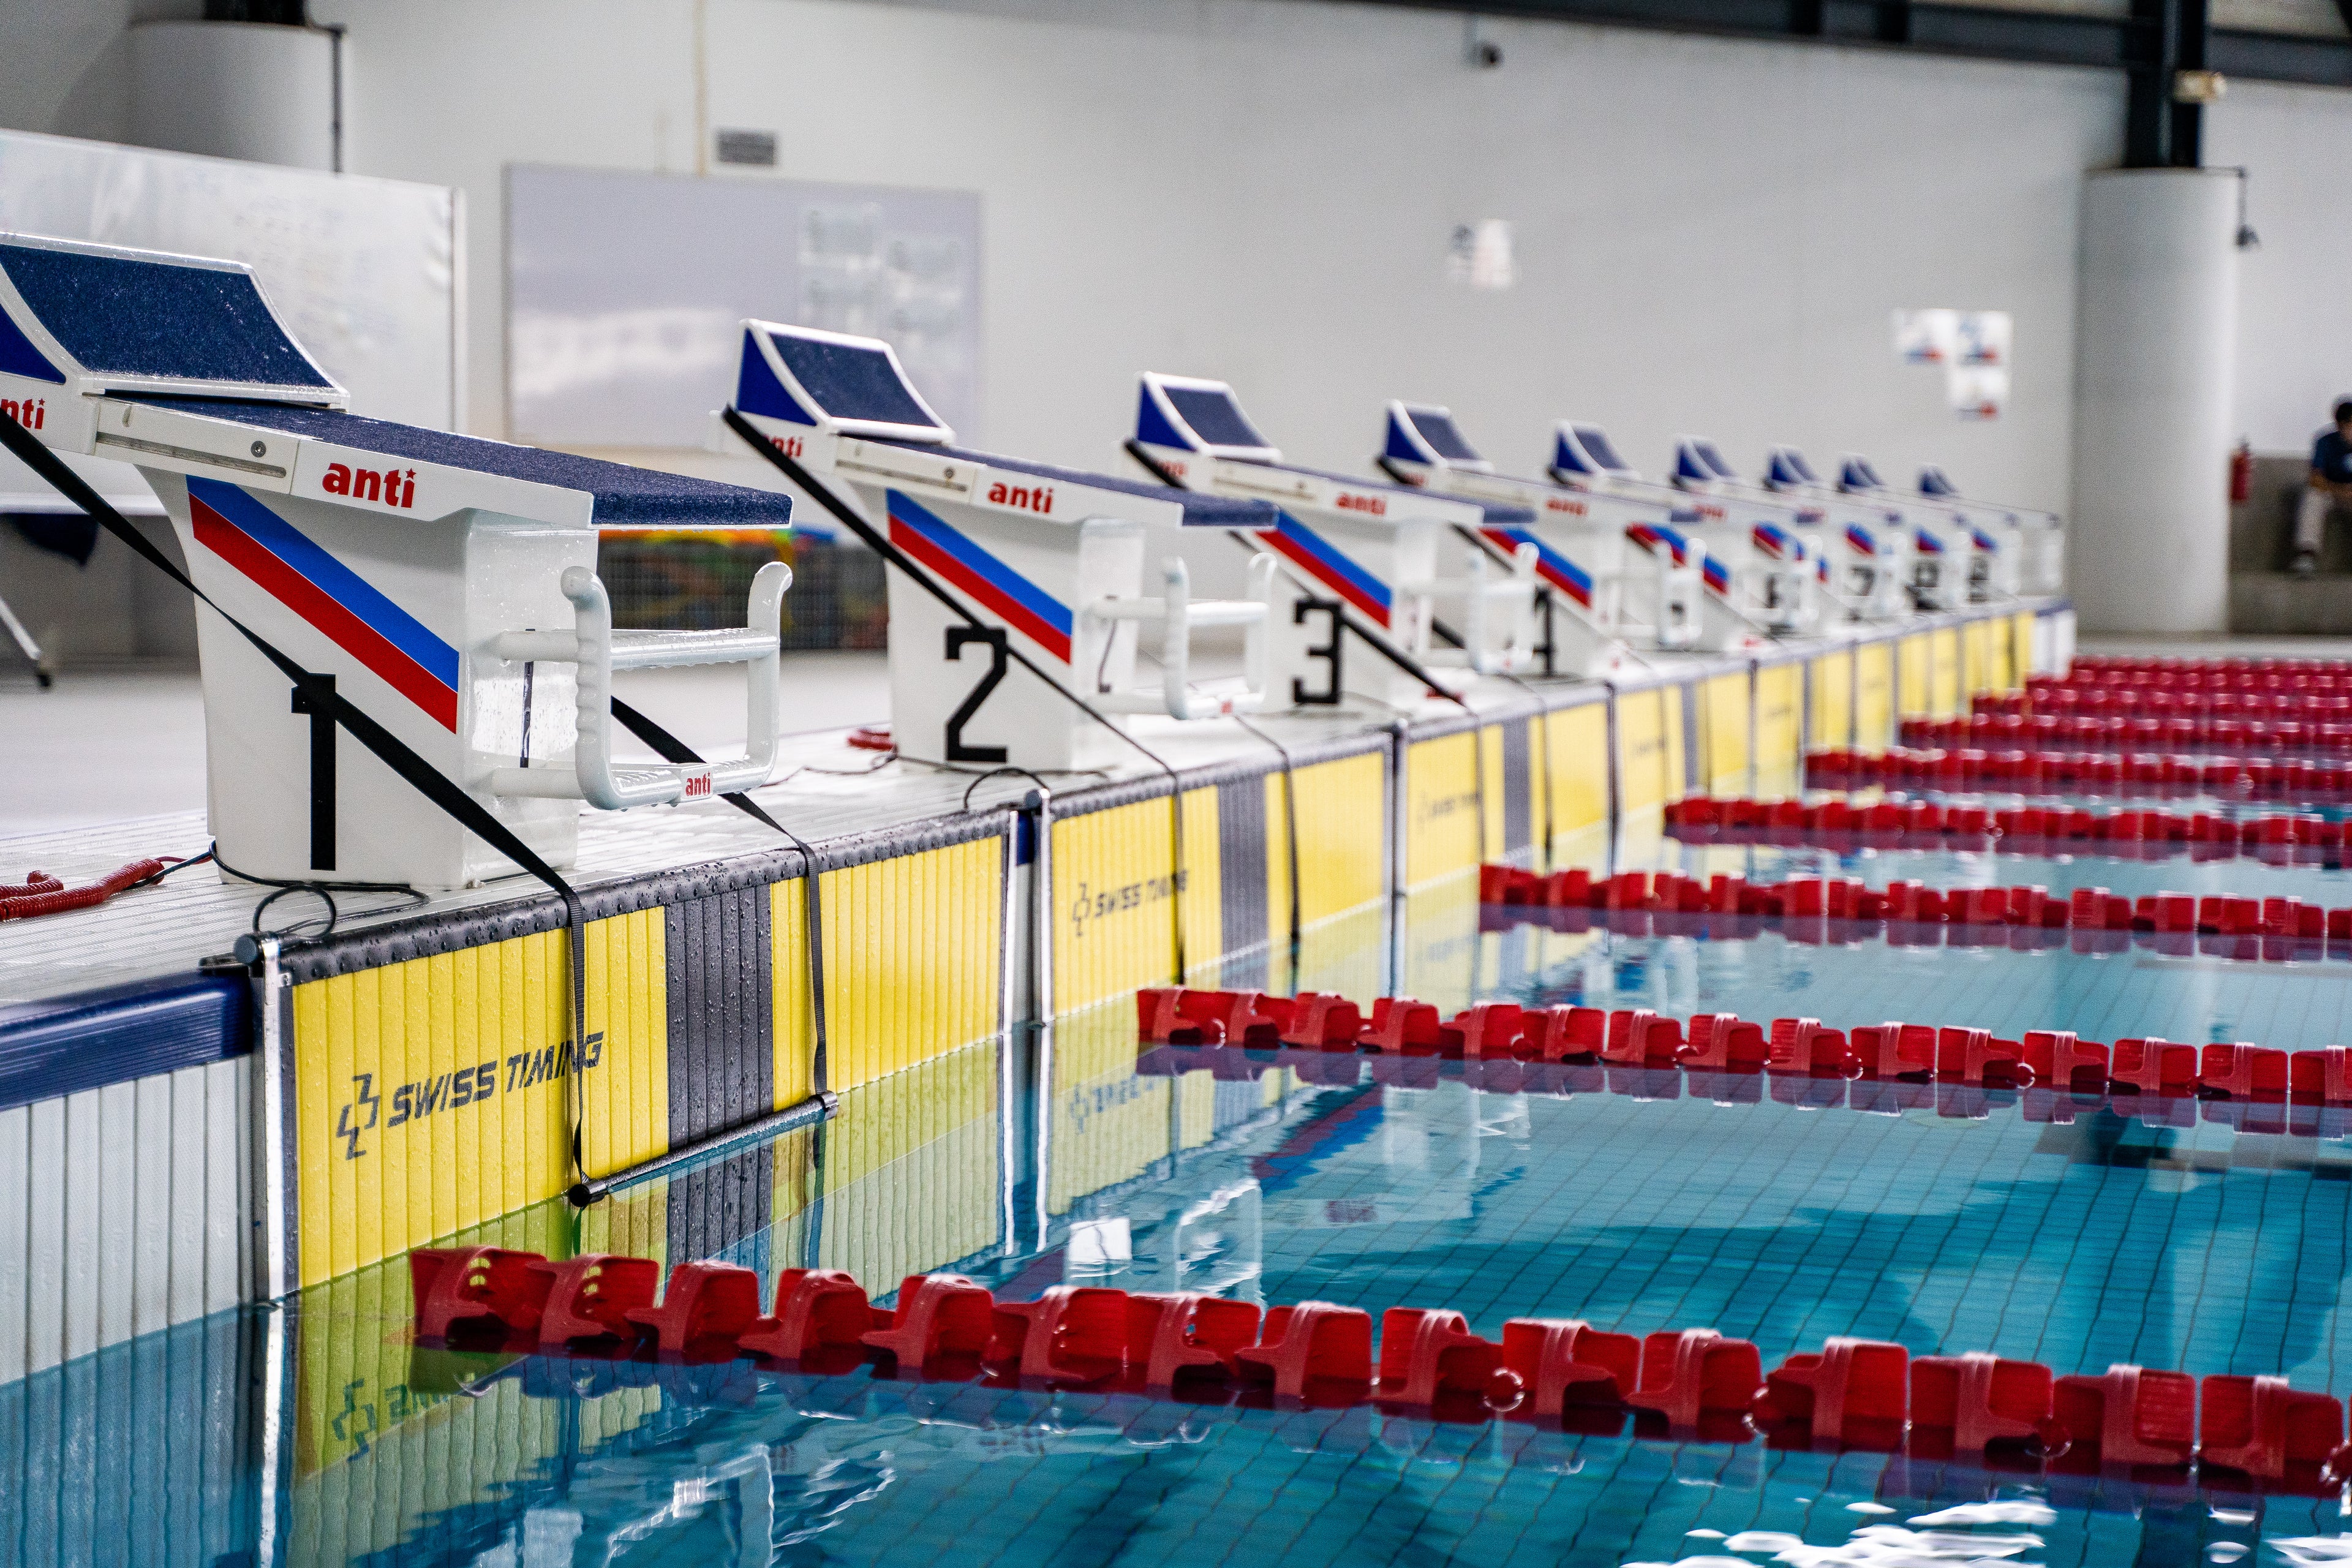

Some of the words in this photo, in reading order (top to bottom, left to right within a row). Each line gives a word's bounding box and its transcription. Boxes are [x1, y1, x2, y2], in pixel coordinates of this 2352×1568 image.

[0, 398, 45, 429] nti
[763, 435, 803, 458] nti
[322, 462, 417, 508] anti
[988, 481, 1054, 514] anti
[1293, 598, 1344, 705] 3
[945, 626, 1007, 763] 2
[291, 673, 336, 871] 1
[685, 771, 710, 796] anti
[386, 1060, 497, 1128] SWISS
[506, 1031, 604, 1093] TIMING
